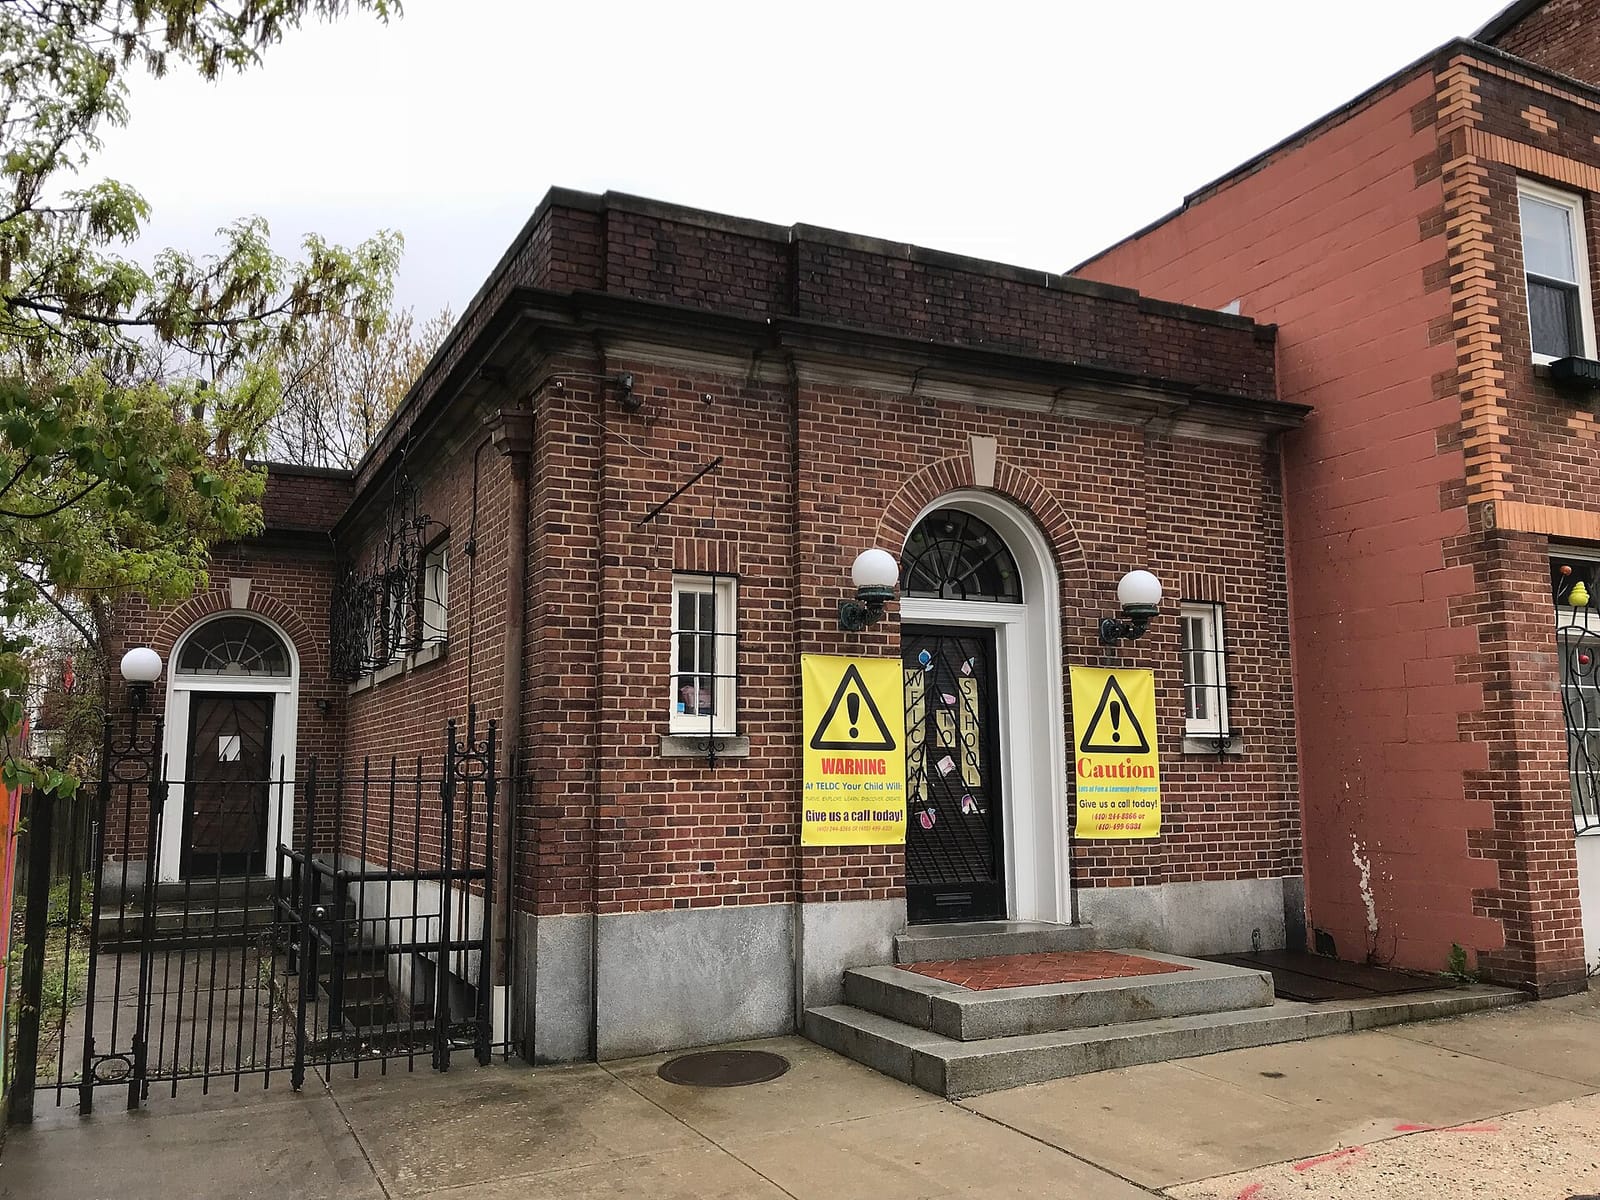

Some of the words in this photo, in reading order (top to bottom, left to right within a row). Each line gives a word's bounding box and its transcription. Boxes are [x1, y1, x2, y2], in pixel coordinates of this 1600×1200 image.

[940, 712, 952, 745] TO
[963, 680, 977, 785] SCHOOL
[821, 758, 886, 775] WARNING
[1077, 757, 1155, 778] Caution
[805, 782, 813, 790] At
[816, 782, 840, 790] TELDC
[842, 782, 861, 790] Your
[864, 782, 883, 790] Child
[1079, 799, 1097, 808] Give
[1118, 800, 1130, 808] call
[1132, 799, 1158, 810] today!
[806, 810, 826, 821] Give
[829, 812, 841, 821] us
[843, 812, 849, 821] a
[851, 810, 870, 821] call
[873, 810, 903, 822] today!
